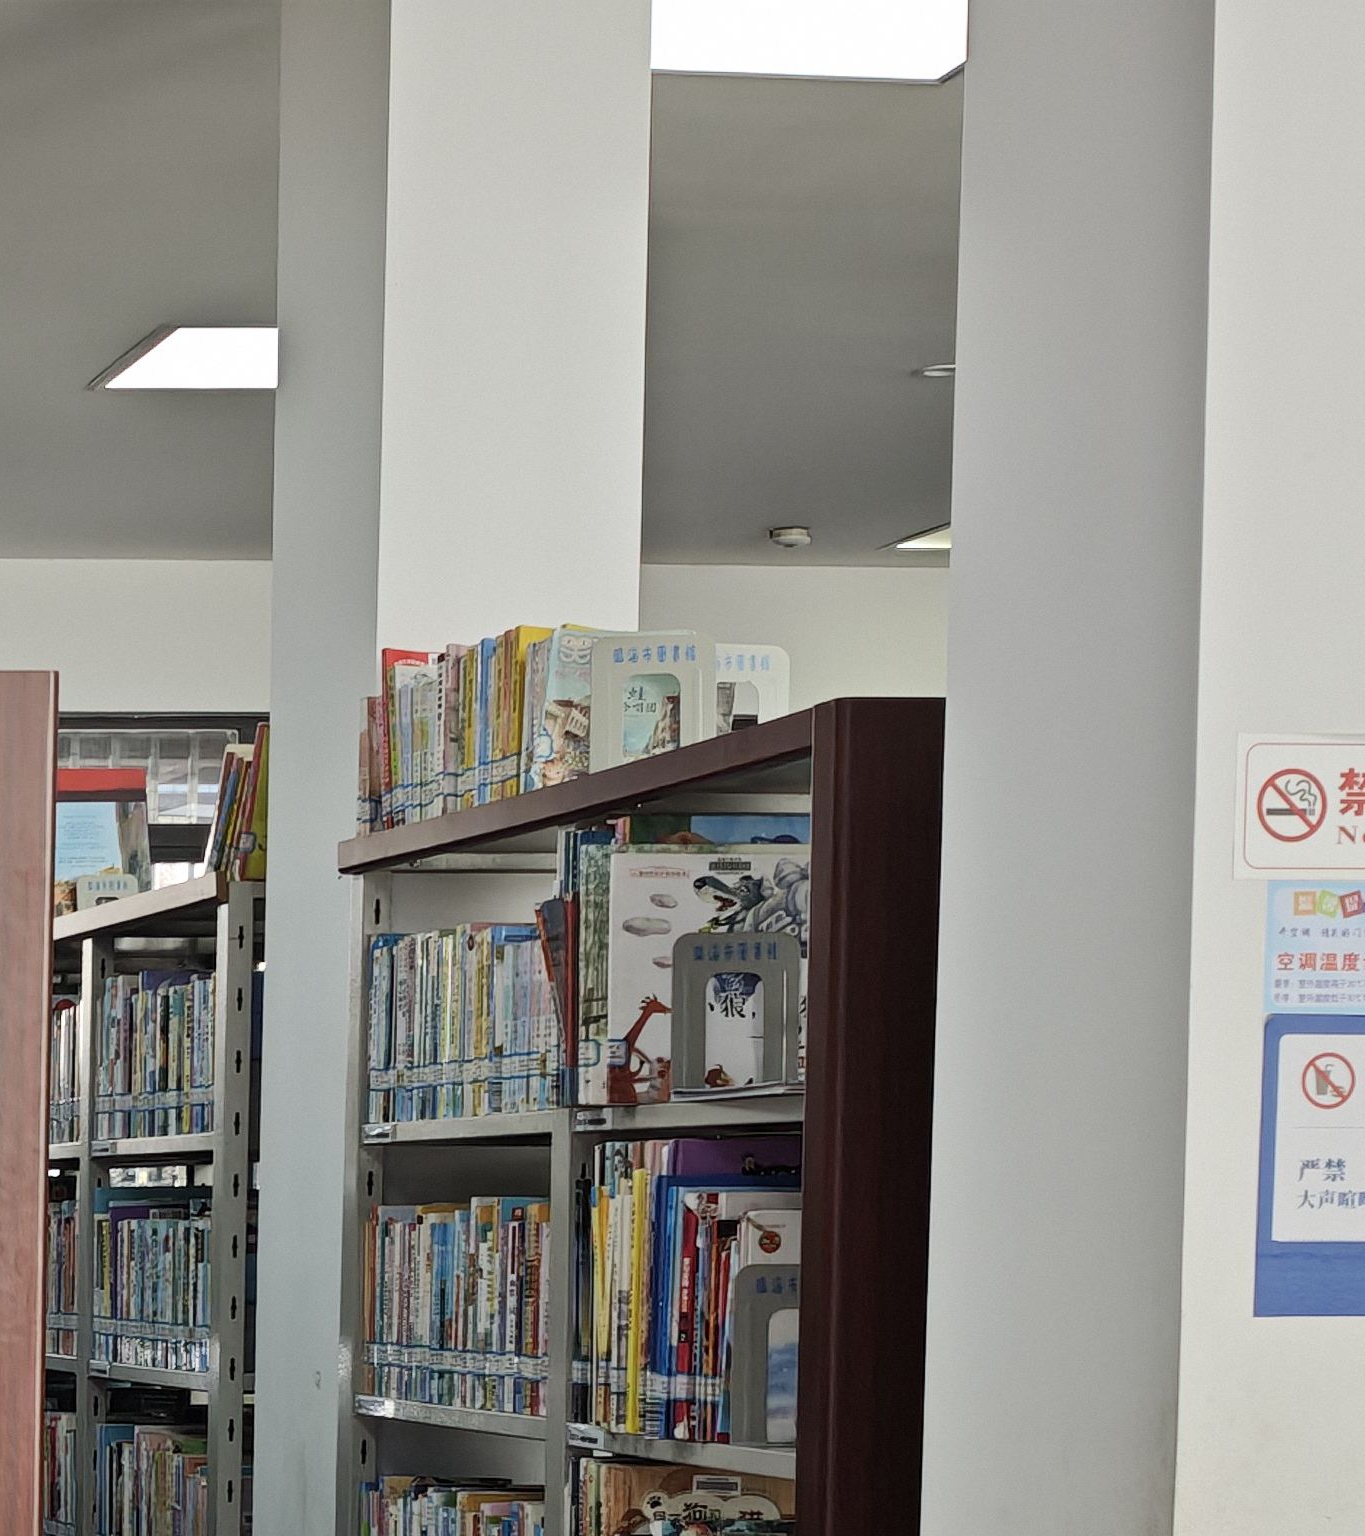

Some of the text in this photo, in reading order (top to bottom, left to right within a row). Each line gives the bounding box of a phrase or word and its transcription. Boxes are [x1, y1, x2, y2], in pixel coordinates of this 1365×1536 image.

[1337, 824, 1365, 845] N
[1277, 952, 1365, 972] 空调温度
[1297, 1158, 1347, 1182] 严禁
